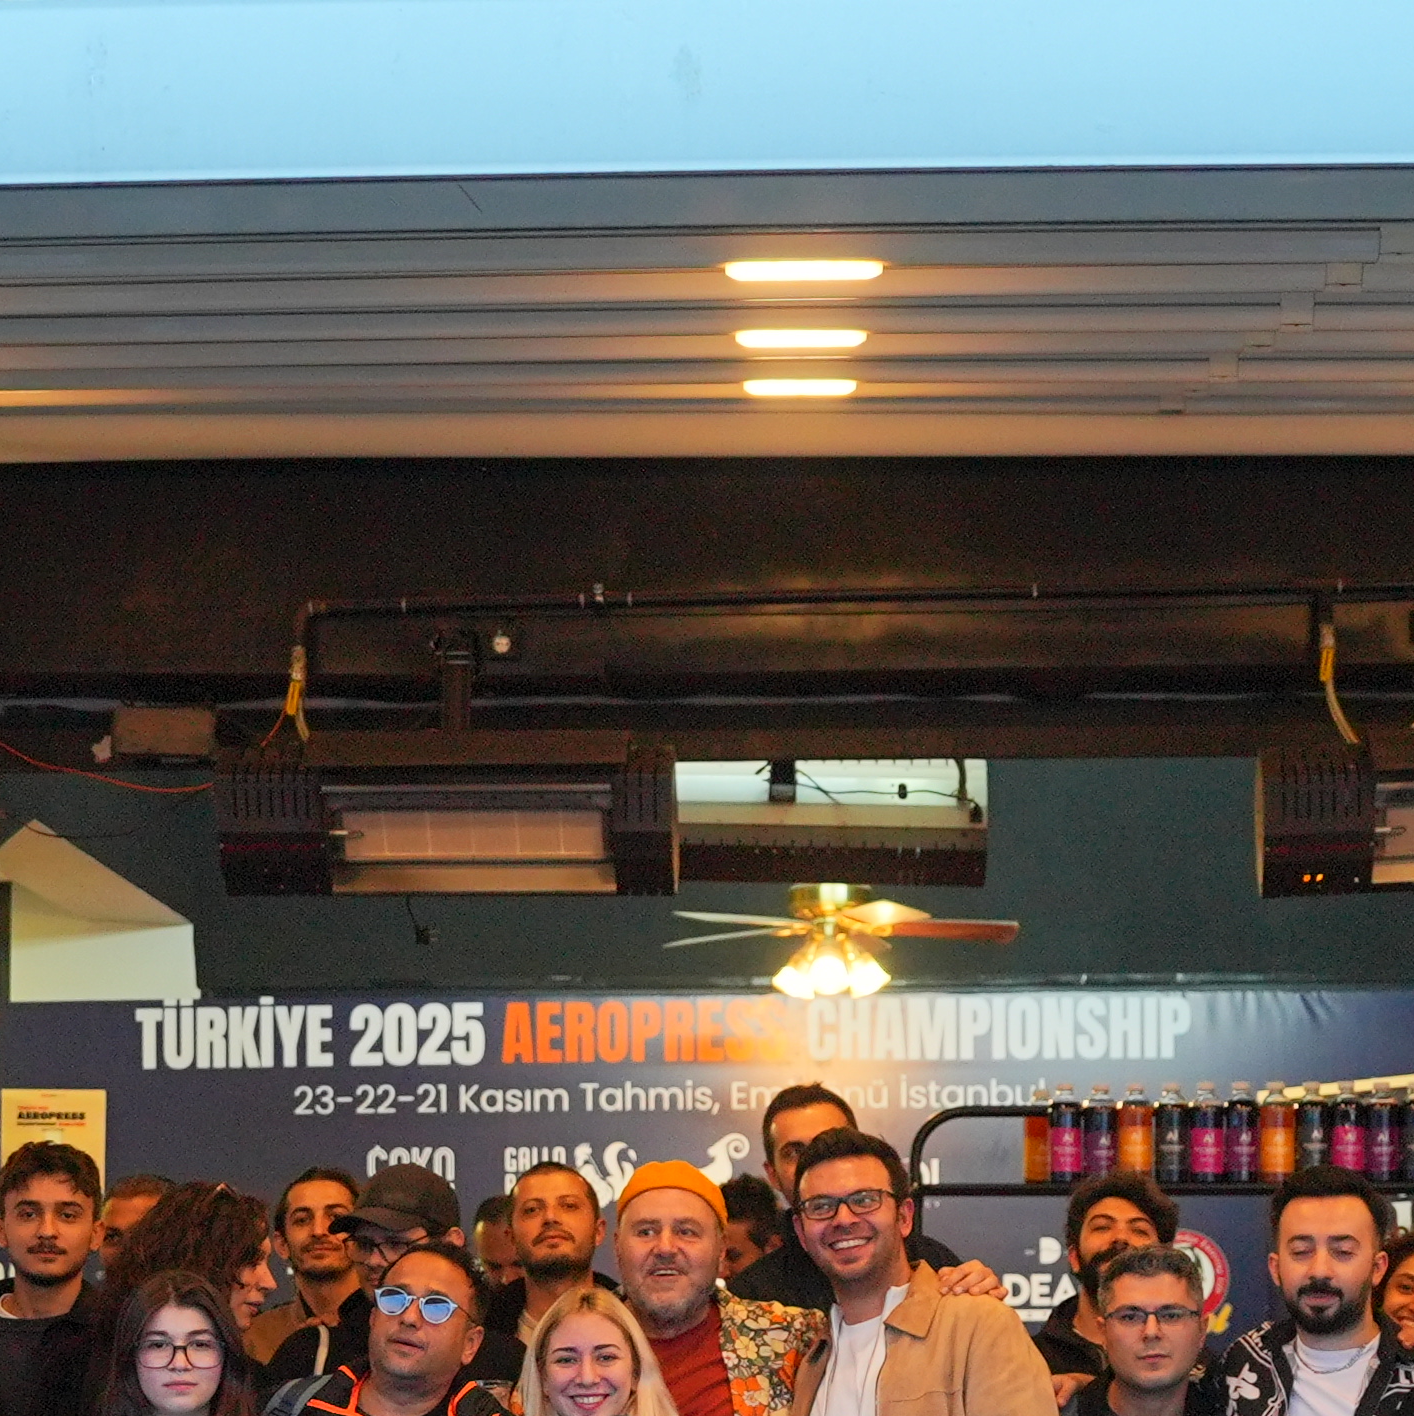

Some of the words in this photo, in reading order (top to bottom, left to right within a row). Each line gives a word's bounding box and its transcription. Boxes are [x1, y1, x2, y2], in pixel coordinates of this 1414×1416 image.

[135, 996, 334, 1070] TÜRKİYE
[349, 1002, 486, 1066] 2025
[501, 1000, 787, 1064] AEROPRESS
[806, 994, 1191, 1061] CHAMPIONSHIP
[293, 1082, 448, 1116] 23-22-21
[458, 1081, 570, 1114] Kasım
[581, 1078, 721, 1116] Tahmis,
